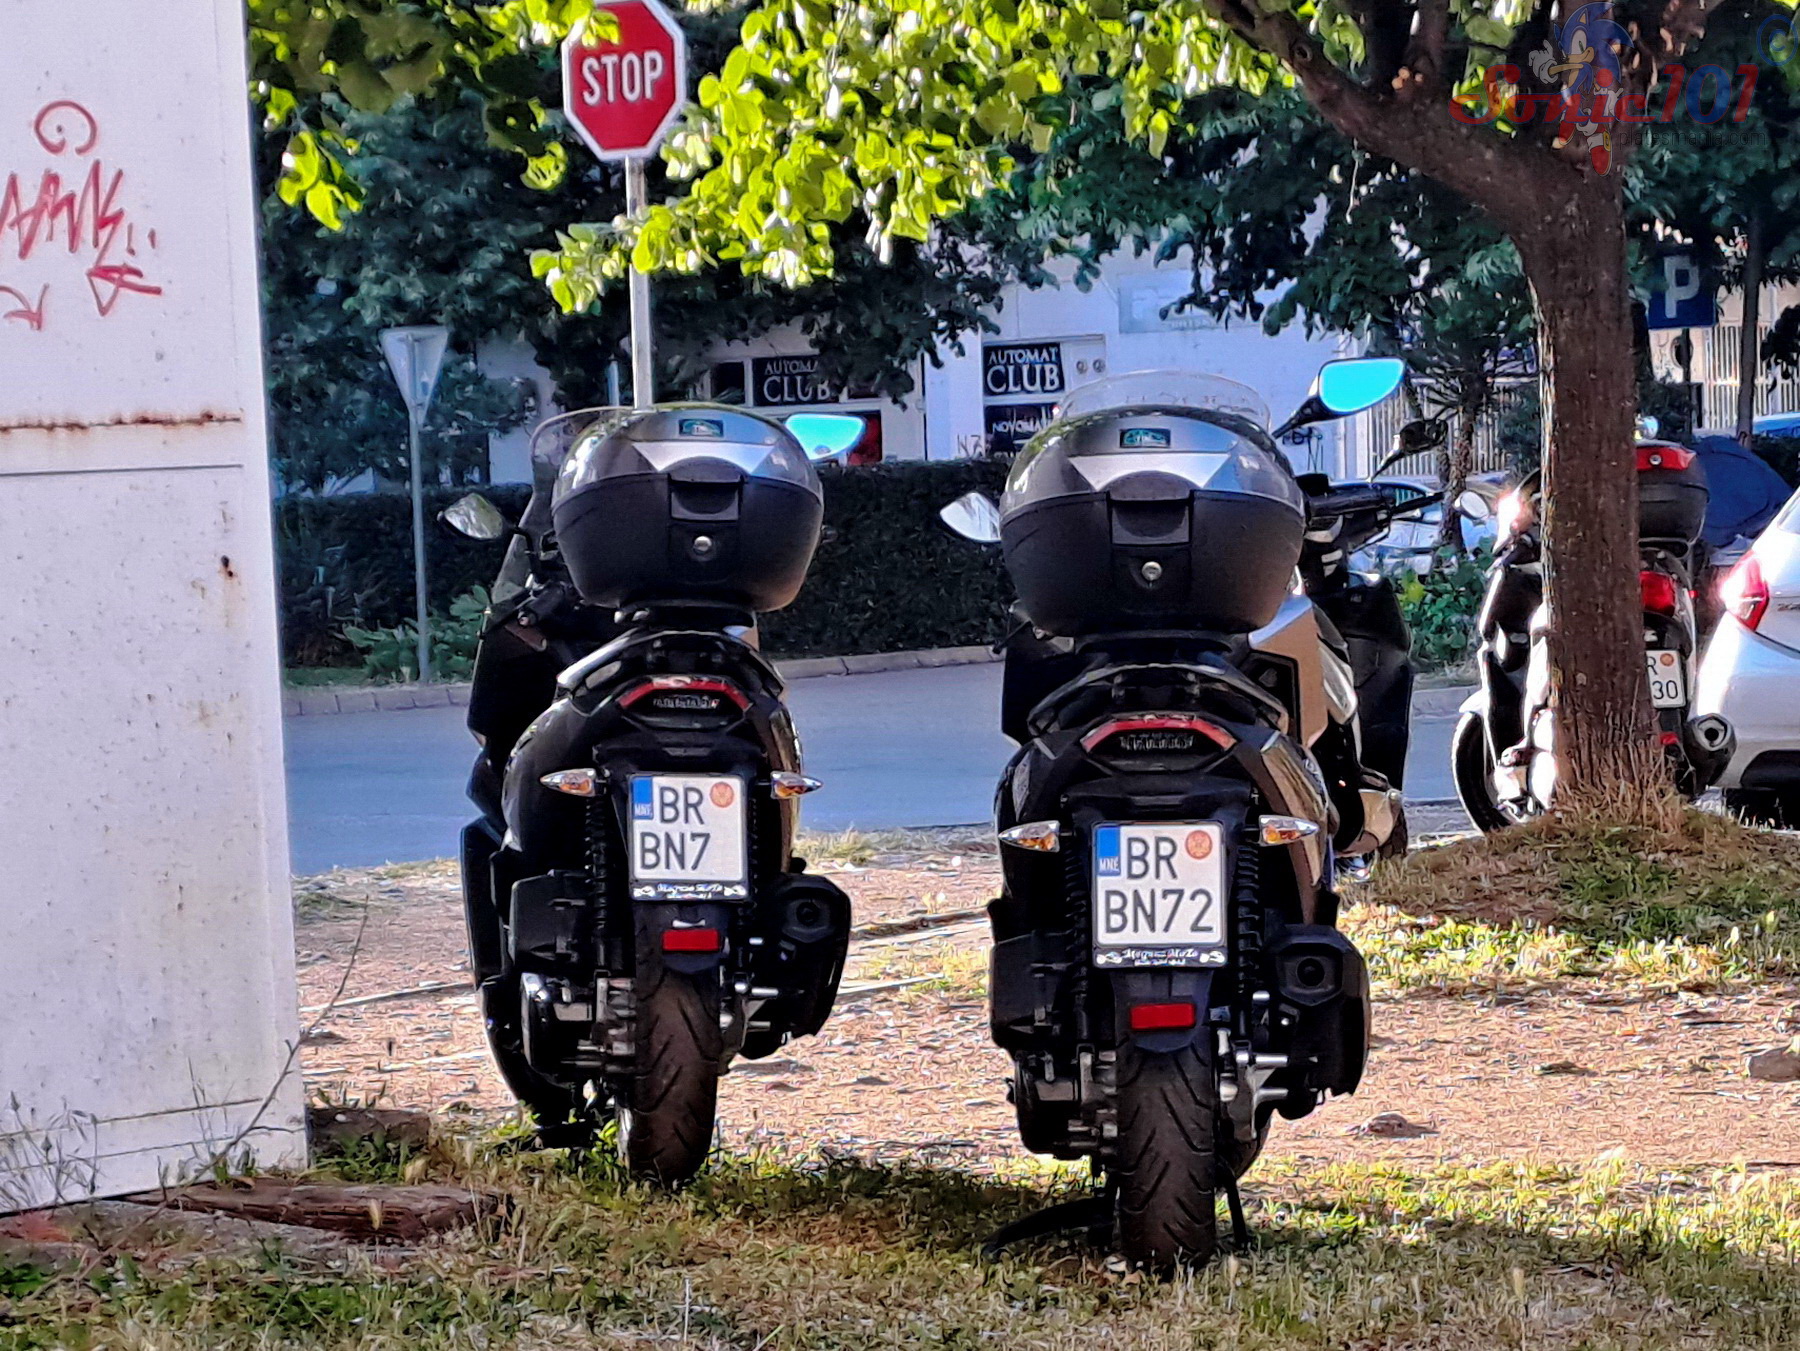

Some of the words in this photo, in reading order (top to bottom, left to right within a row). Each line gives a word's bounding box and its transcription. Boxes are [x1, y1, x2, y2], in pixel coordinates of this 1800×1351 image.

[582, 49, 663, 107] STOP
[1664, 255, 1700, 319] P
[989, 347, 1059, 365] AUTOMAT
[763, 376, 831, 402] CLUB
[986, 363, 1060, 393] CLUB
[1647, 656, 1658, 675] R
[1652, 680, 1678, 700] 30
[659, 786, 705, 825] BR
[640, 831, 711, 871] BN7
[1127, 836, 1178, 880] BR
[1105, 888, 1213, 934] BN72
